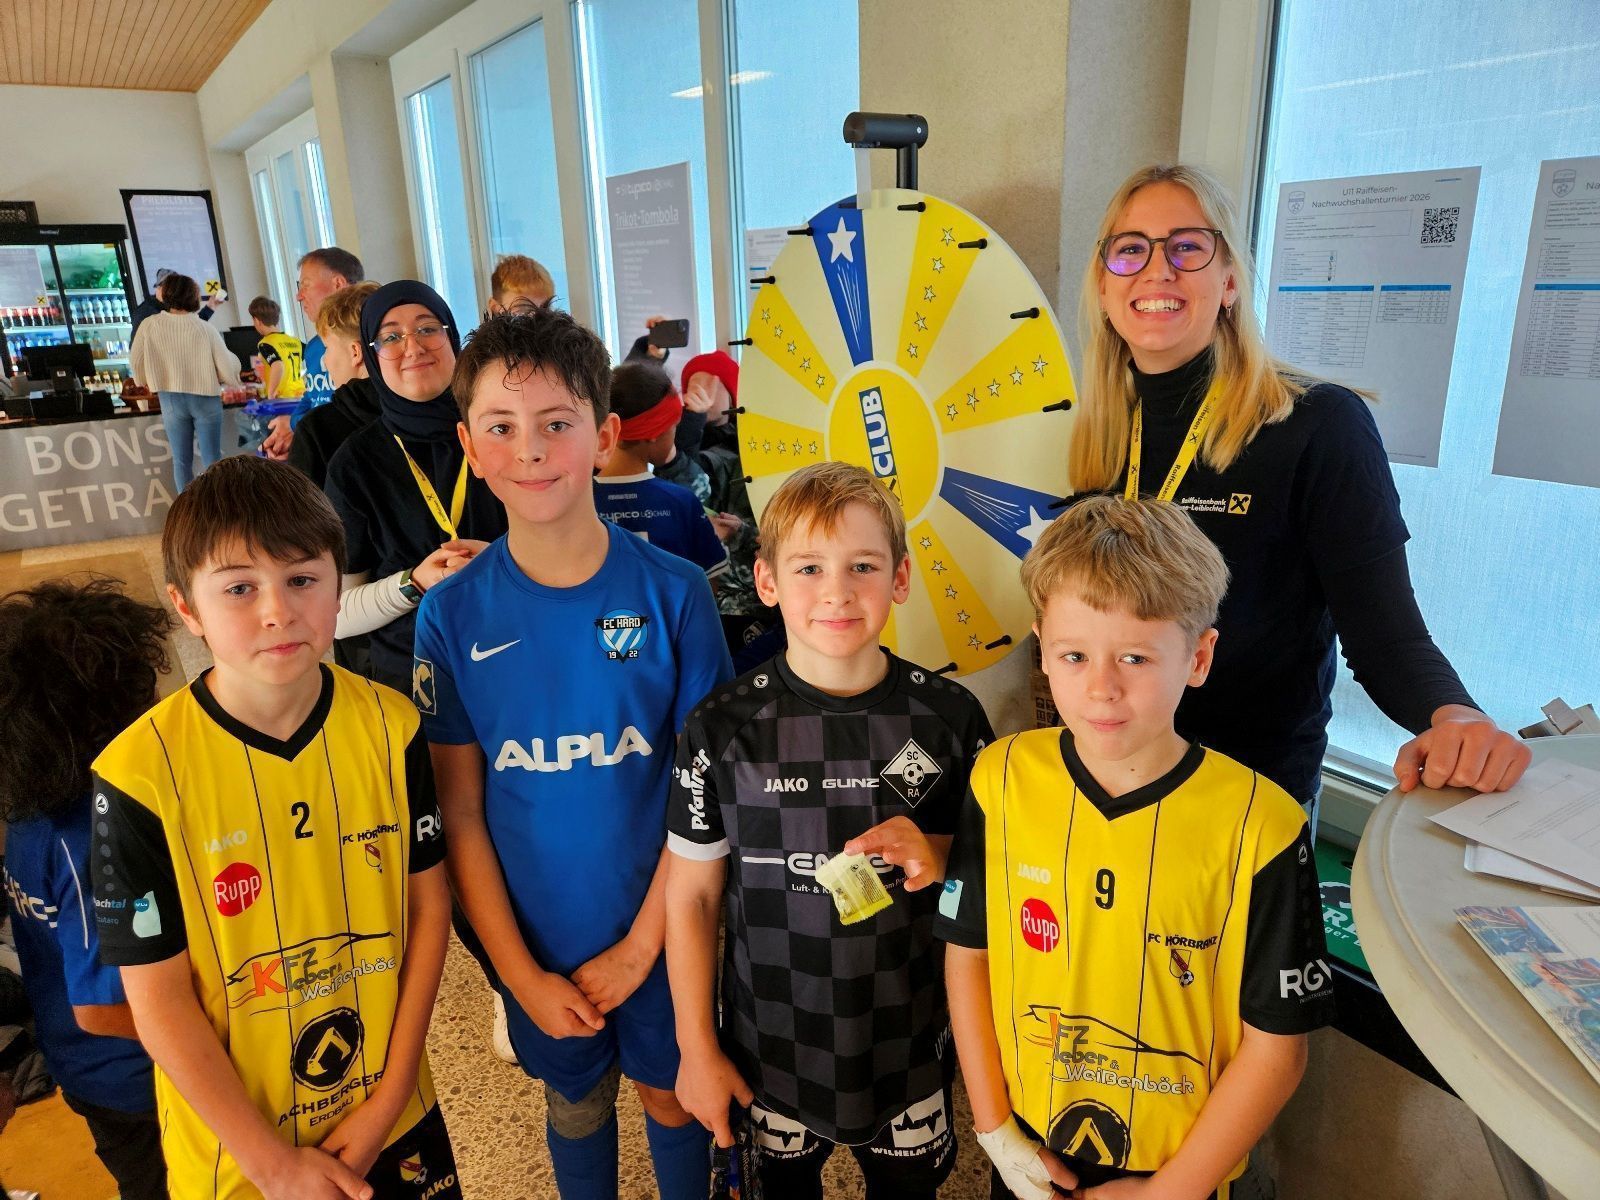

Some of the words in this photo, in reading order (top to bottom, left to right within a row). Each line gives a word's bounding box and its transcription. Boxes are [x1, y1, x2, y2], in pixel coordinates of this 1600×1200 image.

[1356, 185, 1398, 196] Raiffeisen-
[1311, 195, 1407, 209] Nachwuchshallenturnier
[1409, 193, 1431, 203] 2026
[861, 389, 896, 477] CLUB
[25, 424, 173, 476] BONS
[603, 619, 615, 629] FC
[616, 617, 641, 629] HARD
[608, 651, 617, 660] 19
[628, 650, 638, 658] 22
[494, 725, 653, 773] ALPLA
[906, 750, 919, 761] SC
[764, 778, 809, 793] JAKO
[822, 778, 880, 789] GUNZ
[907, 788, 920, 798] RA
[291, 801, 314, 839] 2
[342, 834, 354, 846] FC
[1017, 862, 1052, 885] JAKO
[214, 874, 261, 912] Rupp
[791, 883, 811, 893] Luft-
[1094, 868, 1116, 910] 9
[93, 896, 126, 909] achtal
[1022, 906, 1060, 953] Rupp
[1147, 933, 1161, 944] FC
[1165, 934, 1218, 951] HÖRBRANZ
[1064, 1063, 1195, 1094] Weißenböck
[278, 1070, 385, 1127] ACHBERGER
[309, 1097, 354, 1127] ERDBAU
